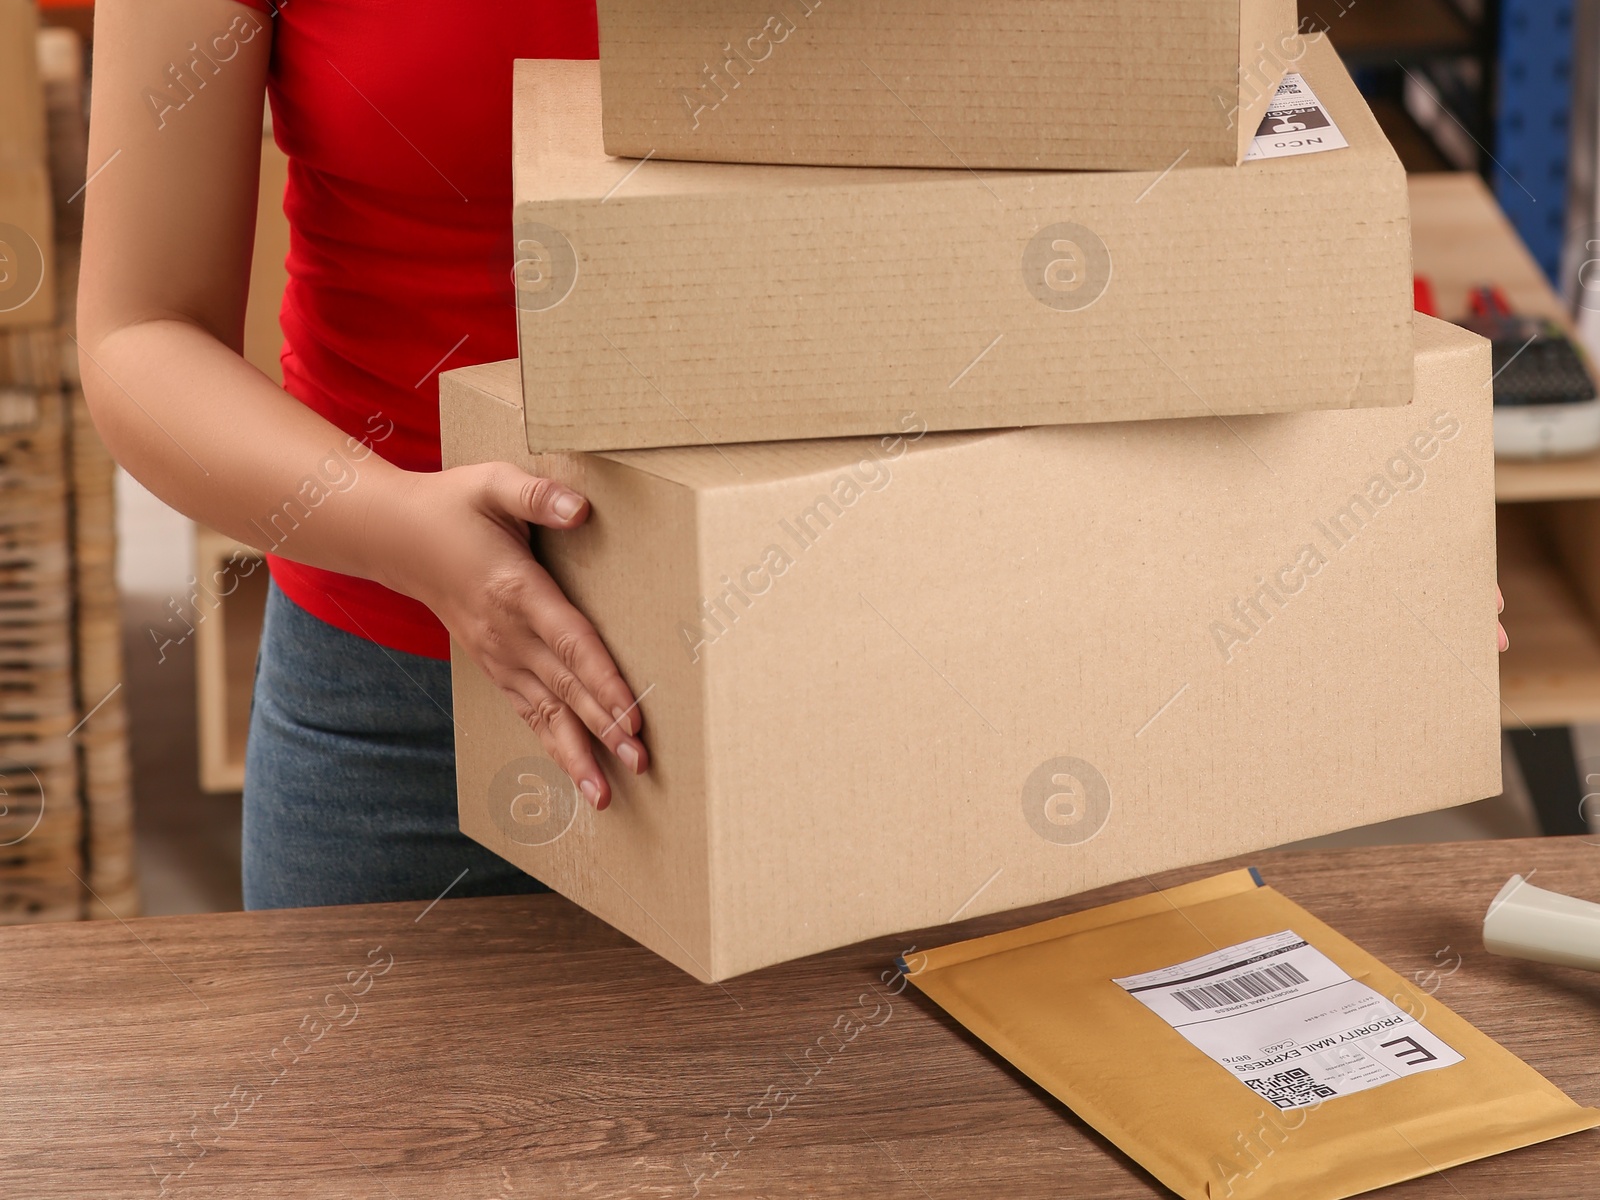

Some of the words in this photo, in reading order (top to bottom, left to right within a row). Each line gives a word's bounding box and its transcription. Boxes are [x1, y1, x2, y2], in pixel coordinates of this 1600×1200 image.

[1264, 107, 1316, 118] FRAGI
[1244, 954, 1265, 964] ONLY
[1264, 987, 1299, 1000] PRIORITY
[1213, 1002, 1248, 1013] EXPRESS
[1247, 997, 1265, 1005] MAIL
[1333, 1014, 1405, 1042] PRIORITY
[1261, 1040, 1295, 1054] C463
[1299, 1037, 1338, 1053] MAIL
[1378, 1035, 1438, 1065] E
[1232, 1048, 1302, 1072] EXPRESS
